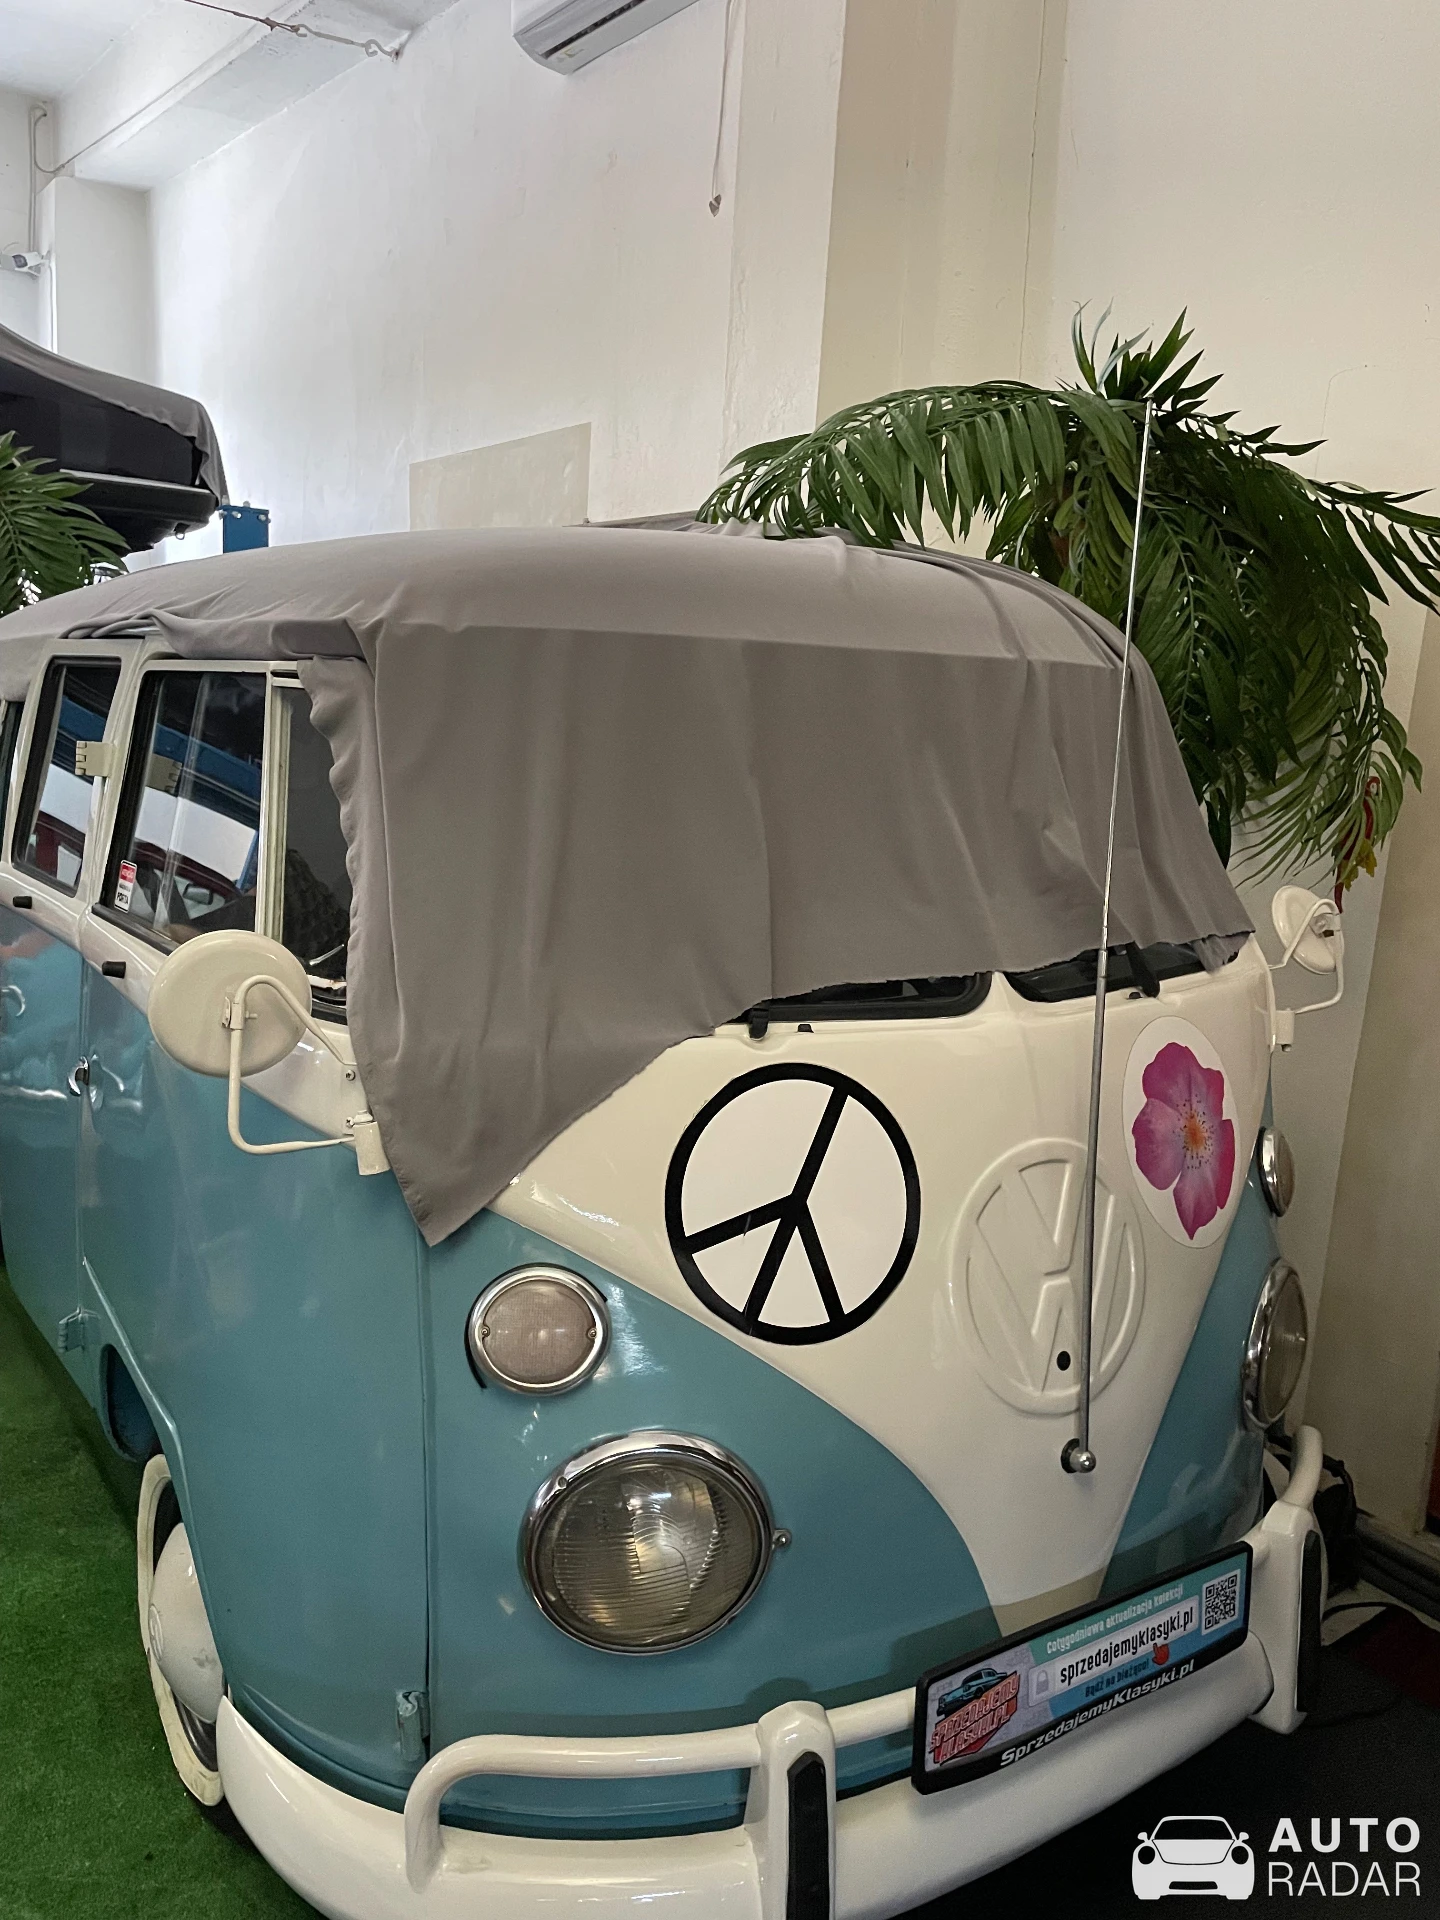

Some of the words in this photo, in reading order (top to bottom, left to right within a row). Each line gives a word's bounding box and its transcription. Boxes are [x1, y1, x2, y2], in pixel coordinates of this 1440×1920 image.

[1105, 1599, 1153, 1629] aktualizacja
[1153, 1583, 1184, 1608] kolekcji
[1060, 1606, 1193, 1687] sprzedajemyklasyki.pl
[1000, 1659, 1195, 1766] SprzedajemyKlasyki.pl
[1105, 1675, 1116, 1688] na
